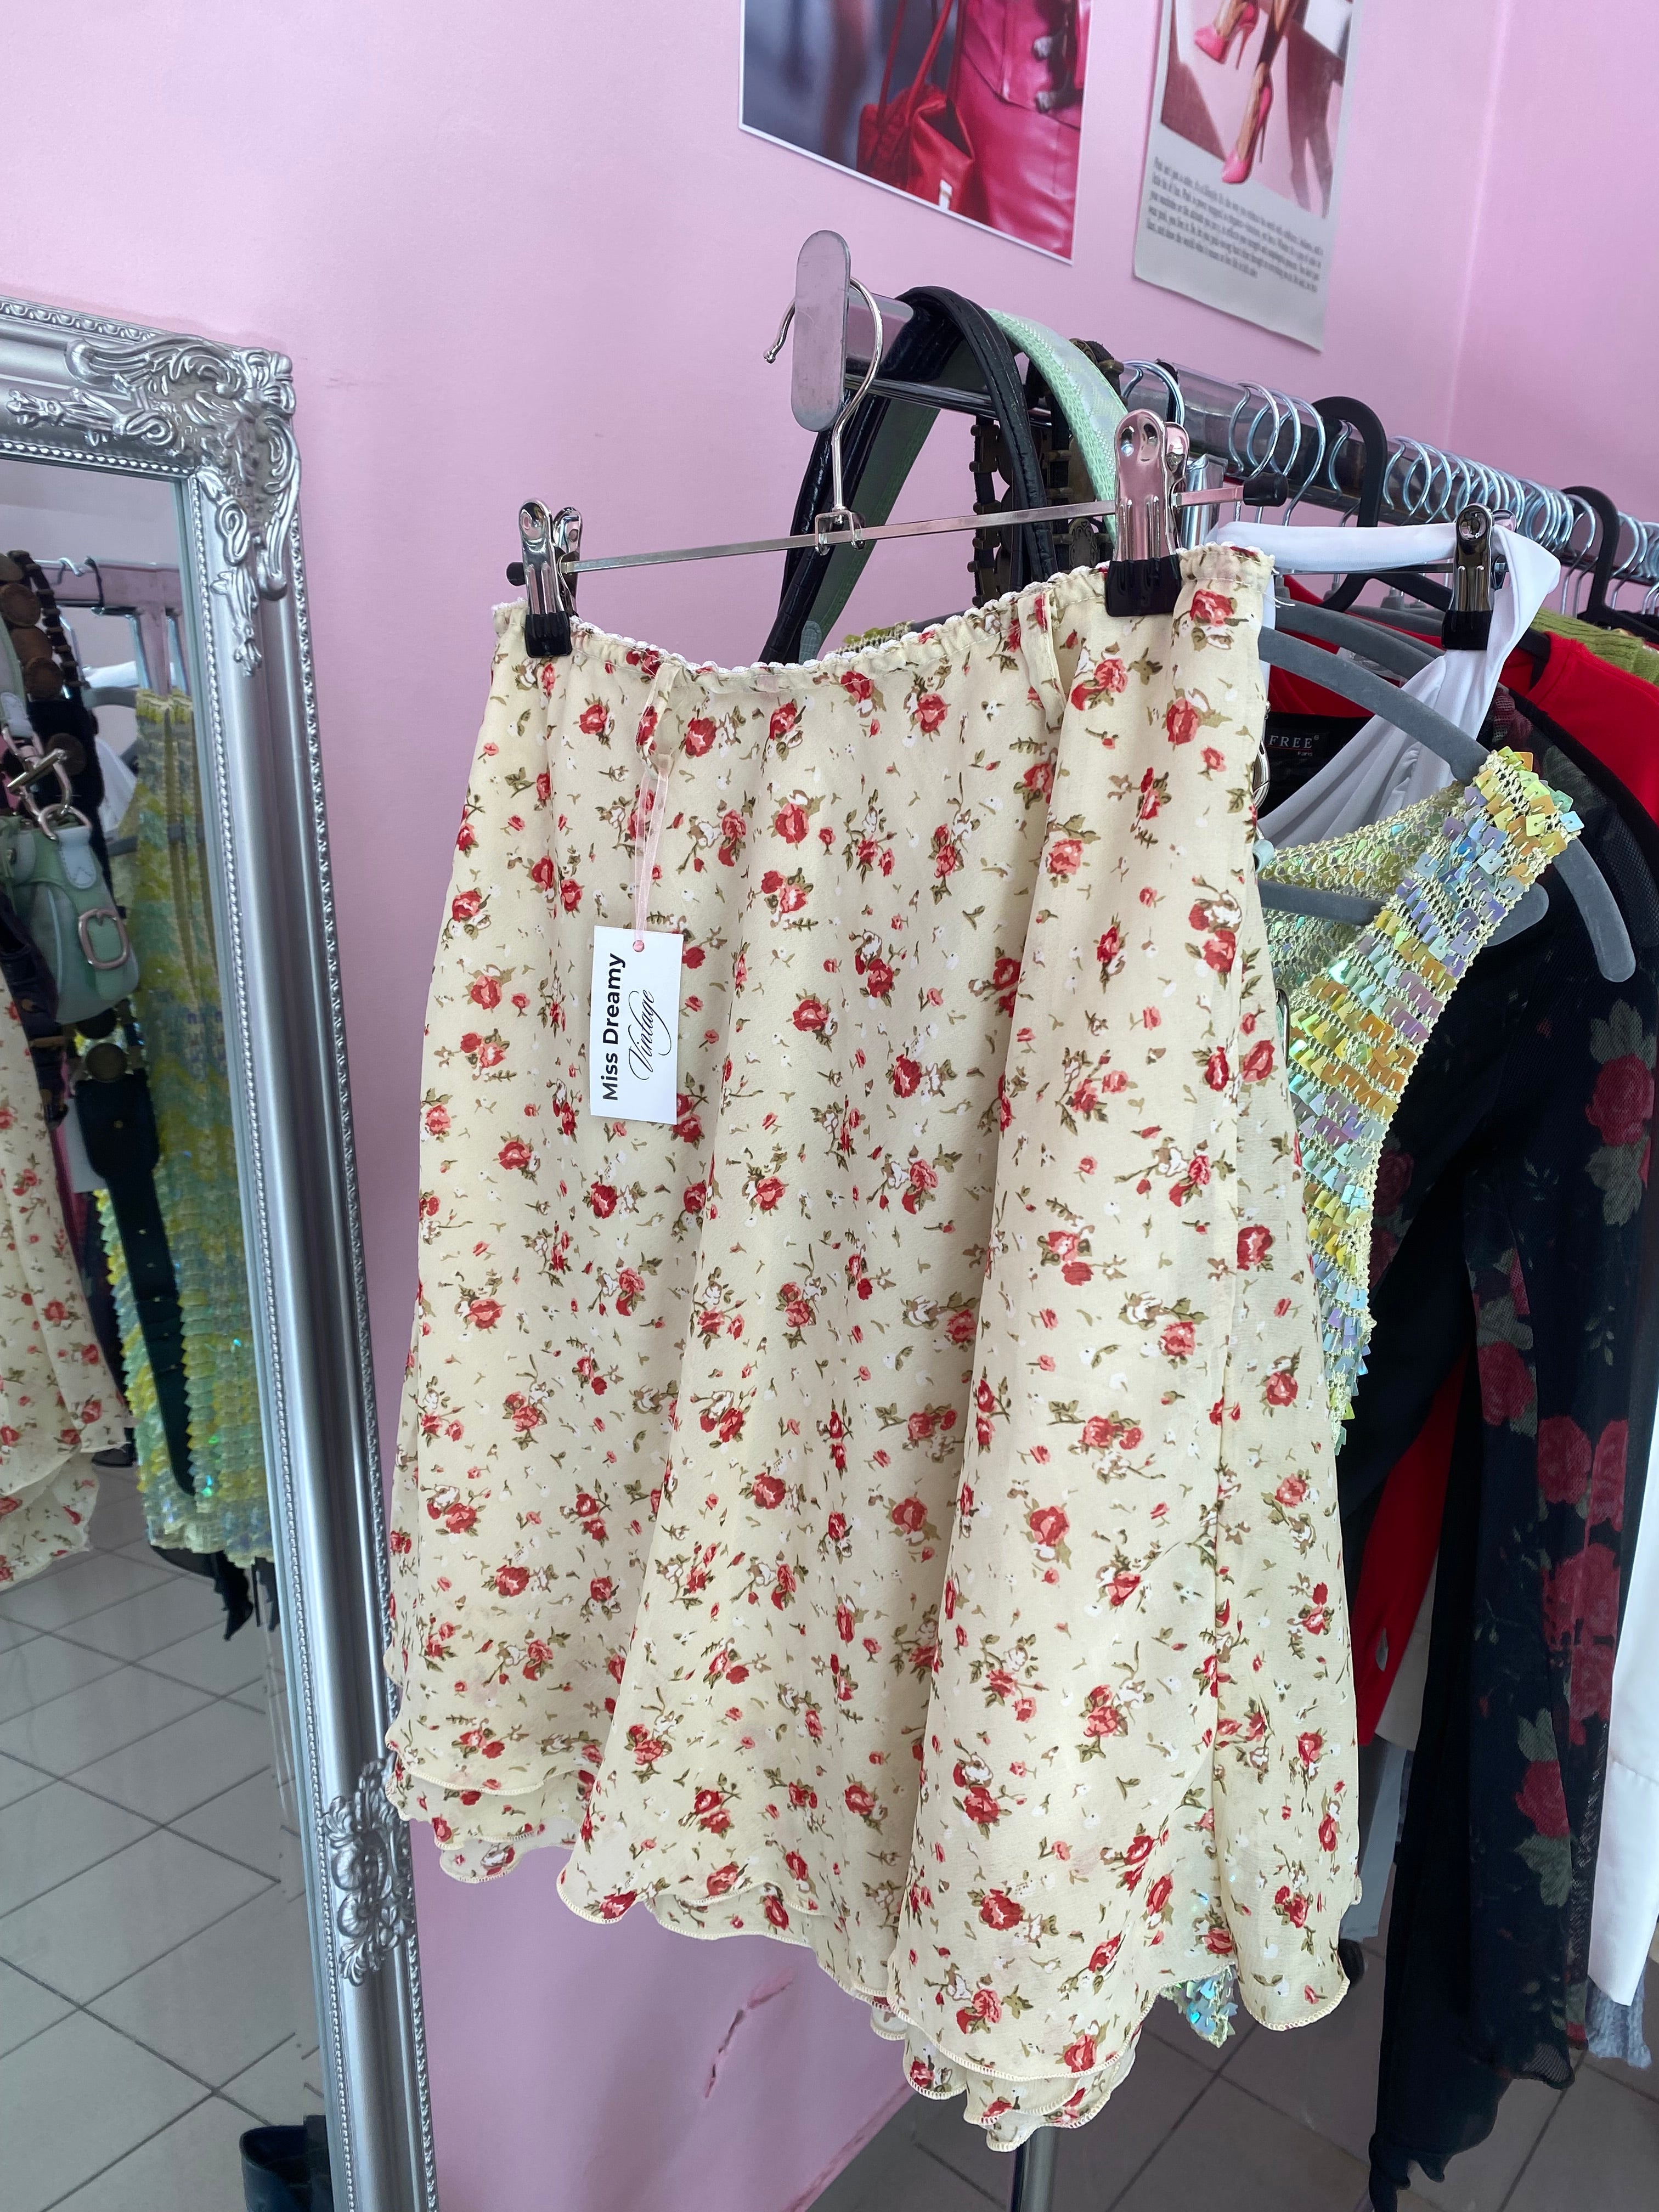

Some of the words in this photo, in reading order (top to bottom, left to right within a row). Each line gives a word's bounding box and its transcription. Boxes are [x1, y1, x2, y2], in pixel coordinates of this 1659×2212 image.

[603, 953, 626, 1045] Dreamy
[628, 989, 672, 1080] Vintage
[601, 1053, 618, 1101] Miss
